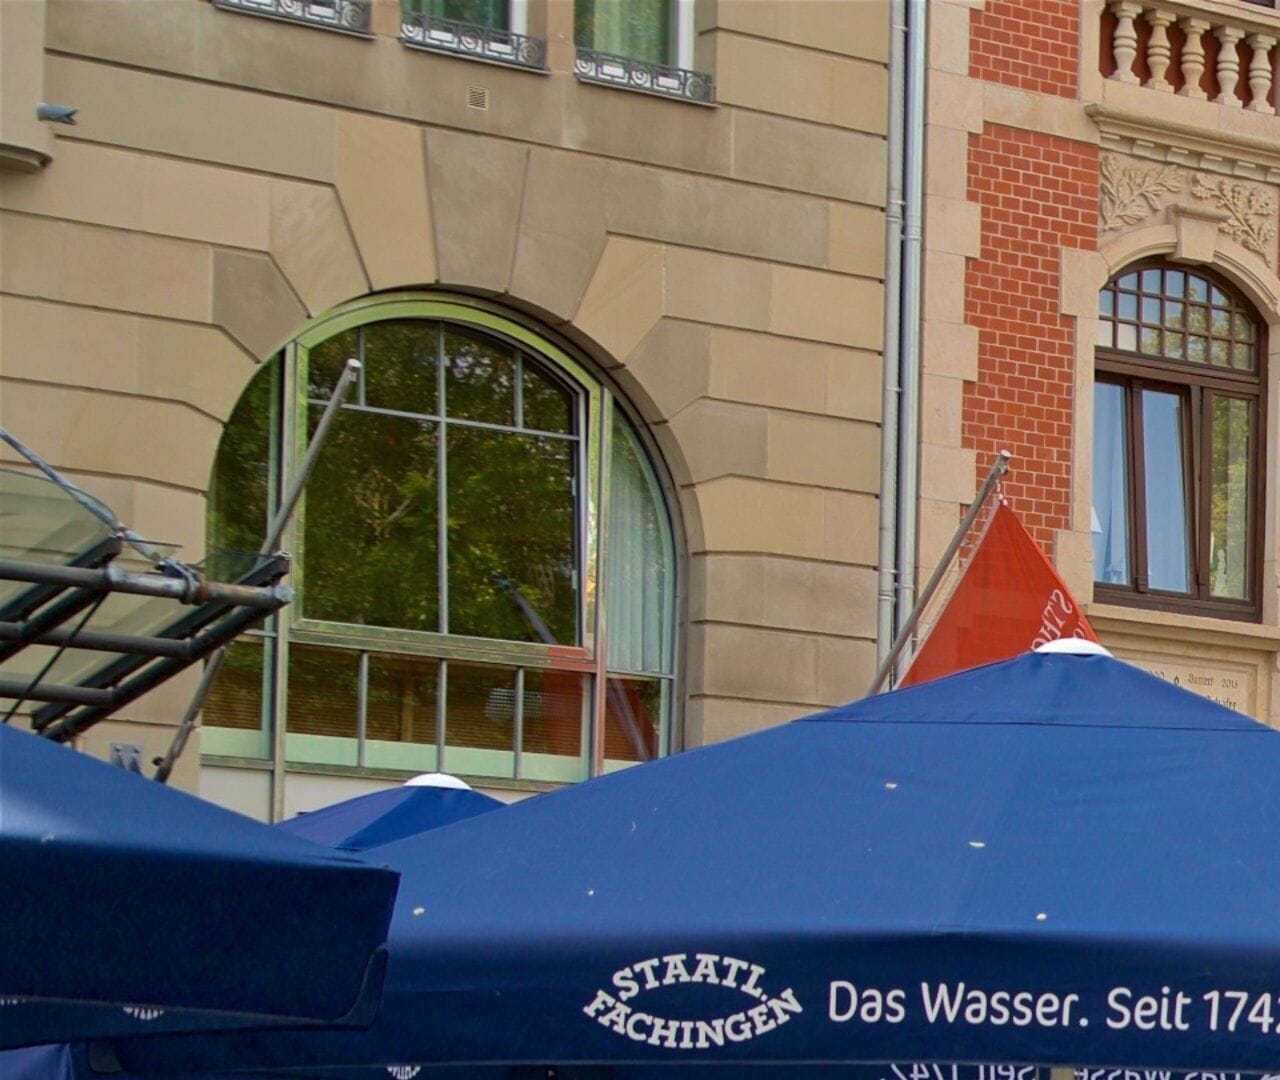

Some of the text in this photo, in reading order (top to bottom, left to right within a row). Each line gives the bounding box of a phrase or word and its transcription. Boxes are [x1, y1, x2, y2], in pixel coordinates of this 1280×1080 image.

[612, 953, 767, 1001] STAATL.
[583, 988, 803, 1049] FACHINGEN
[829, 980, 906, 1024] Das
[921, 982, 1088, 1028] Wasser.
[1106, 986, 1192, 1031] Seit
